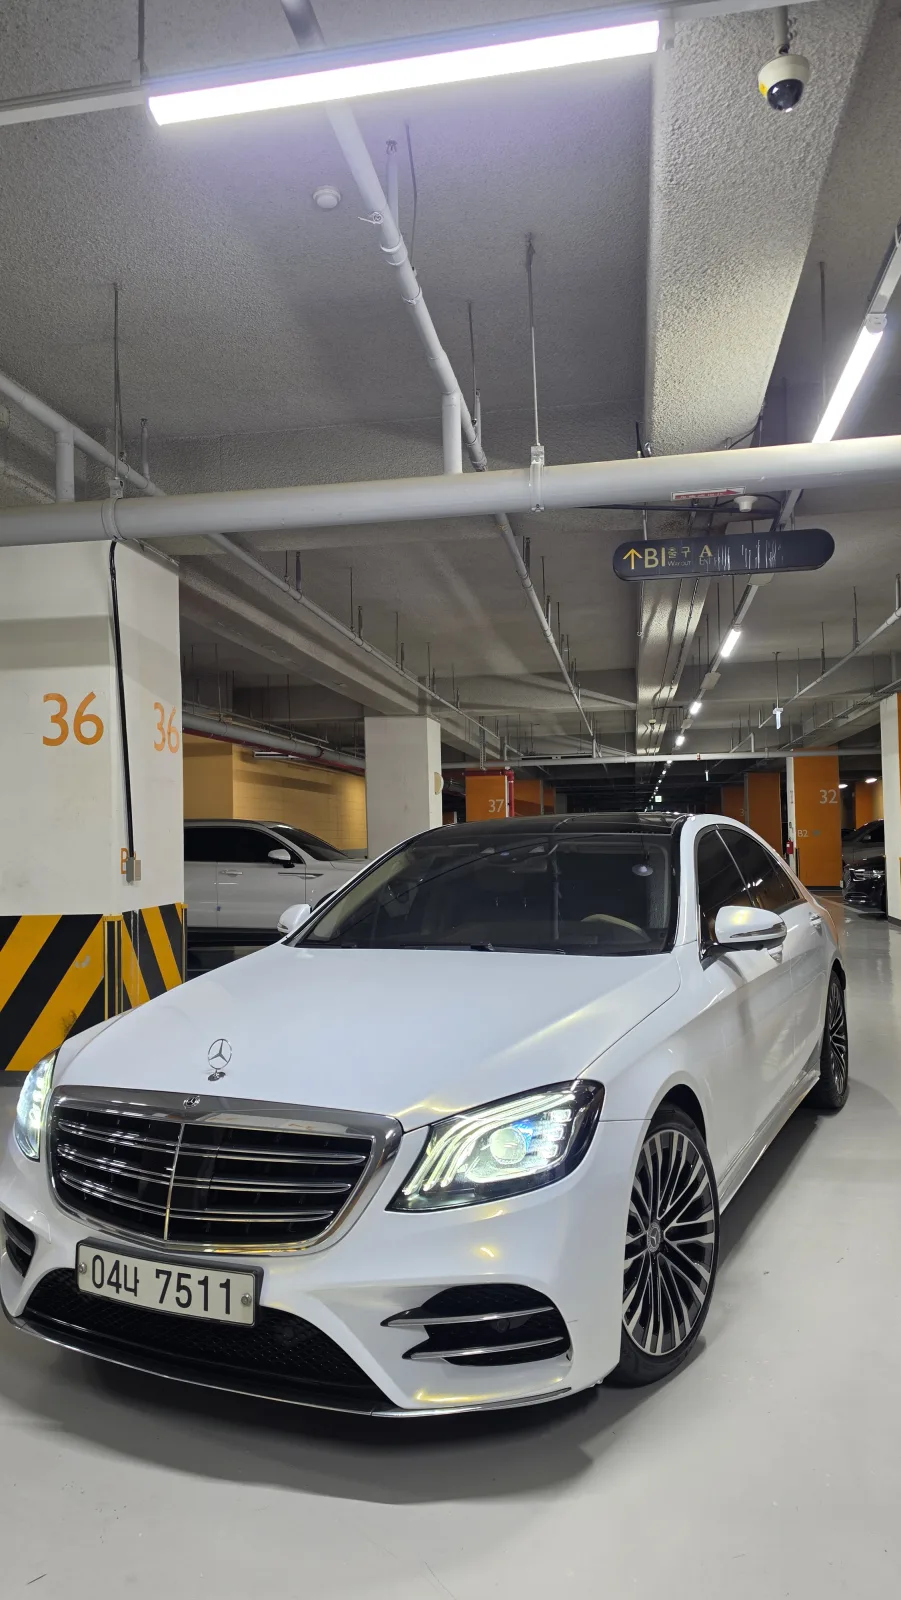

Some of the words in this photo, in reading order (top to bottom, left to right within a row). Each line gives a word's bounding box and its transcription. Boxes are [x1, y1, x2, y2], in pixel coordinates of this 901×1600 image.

[42, 691, 104, 746] 36
[153, 702, 179, 753] 36
[488, 799, 504, 813] 37
[819, 789, 838, 804] 32
[797, 829, 808, 837] B2
[92, 1254, 139, 1297] 04나
[155, 1268, 231, 1315] 7511
